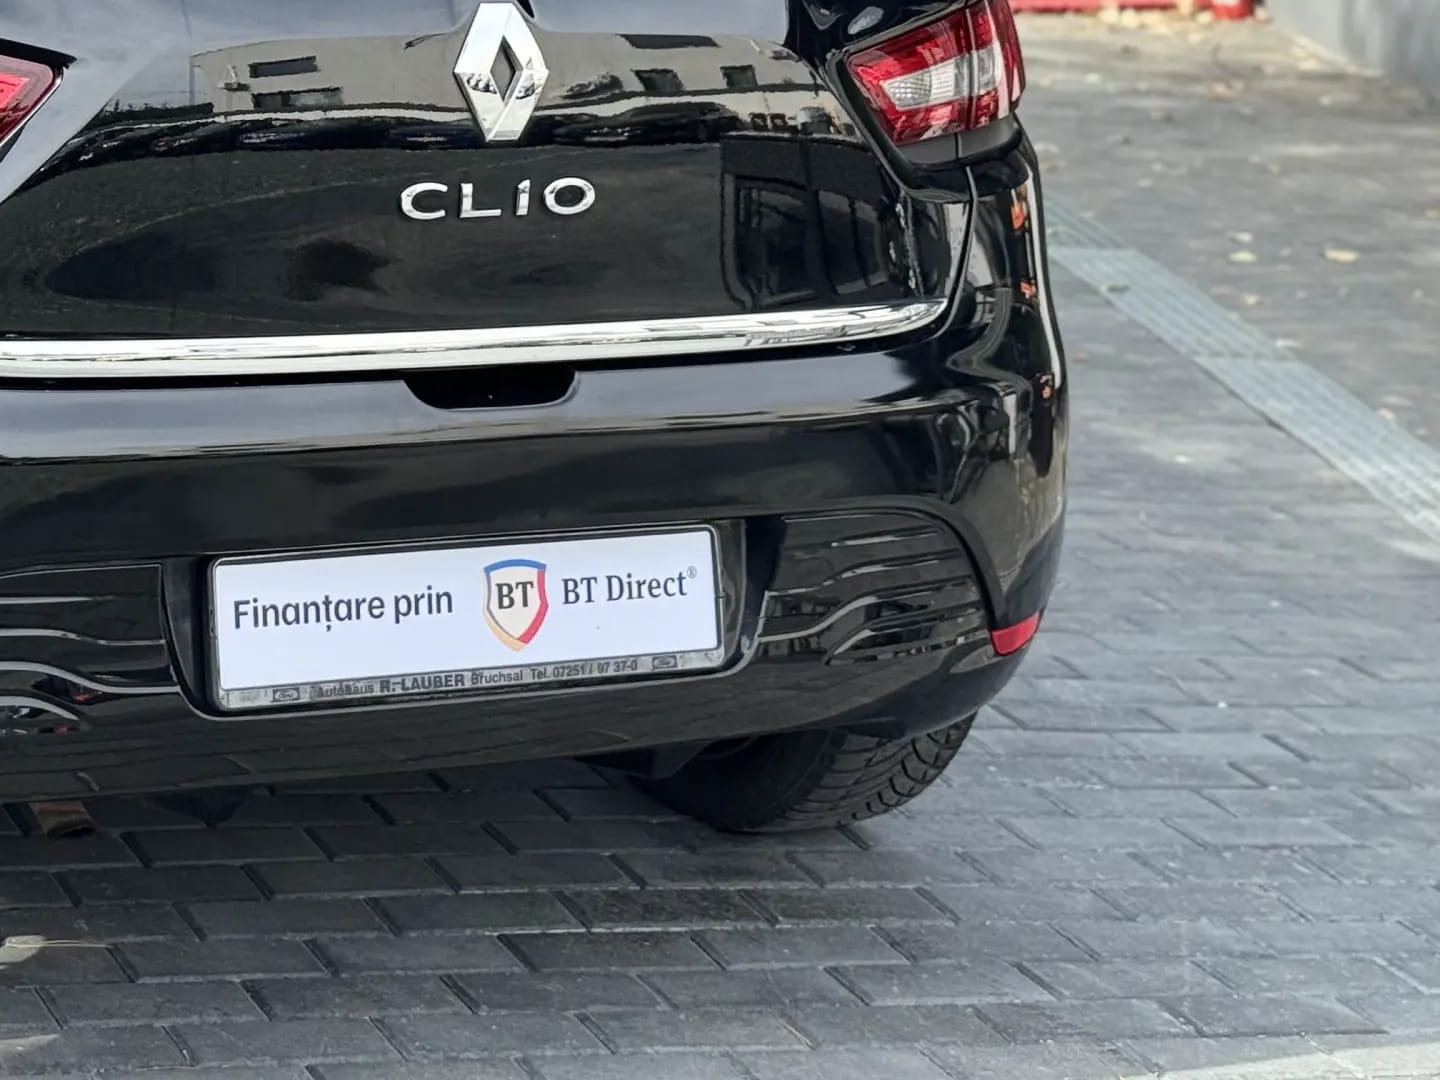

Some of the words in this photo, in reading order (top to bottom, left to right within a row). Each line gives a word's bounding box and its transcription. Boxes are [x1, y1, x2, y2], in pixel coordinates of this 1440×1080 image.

[401, 177, 596, 220] CLIO
[234, 595, 385, 632] Finanțare
[394, 585, 454, 624] prin
[495, 581, 534, 610] BT
[562, 577, 598, 605] BT
[470, 670, 524, 686] Bruchsal
[530, 668, 550, 680] Tel.
[553, 664, 585, 678] 07251
[597, 662, 611, 674] 97
